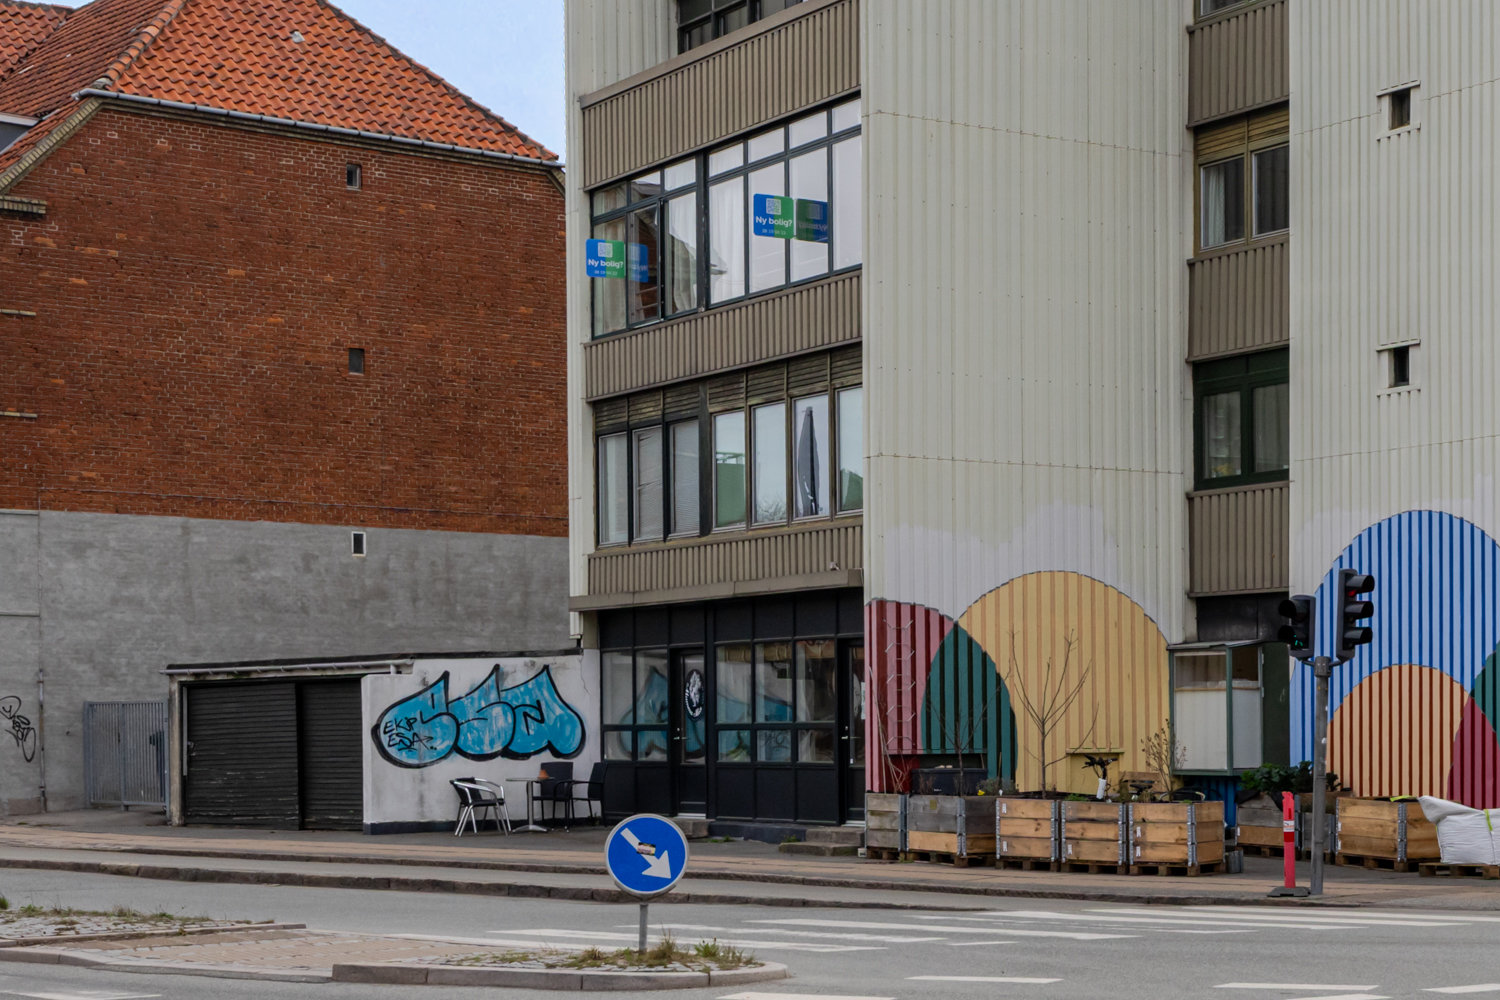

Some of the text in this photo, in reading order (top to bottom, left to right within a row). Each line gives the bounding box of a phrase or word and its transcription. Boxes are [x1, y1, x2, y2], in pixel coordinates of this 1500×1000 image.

[756, 216, 767, 226] Ny
[769, 217, 793, 228] bolig?
[588, 259, 599, 268] Ny
[600, 260, 624, 269] bolig?
